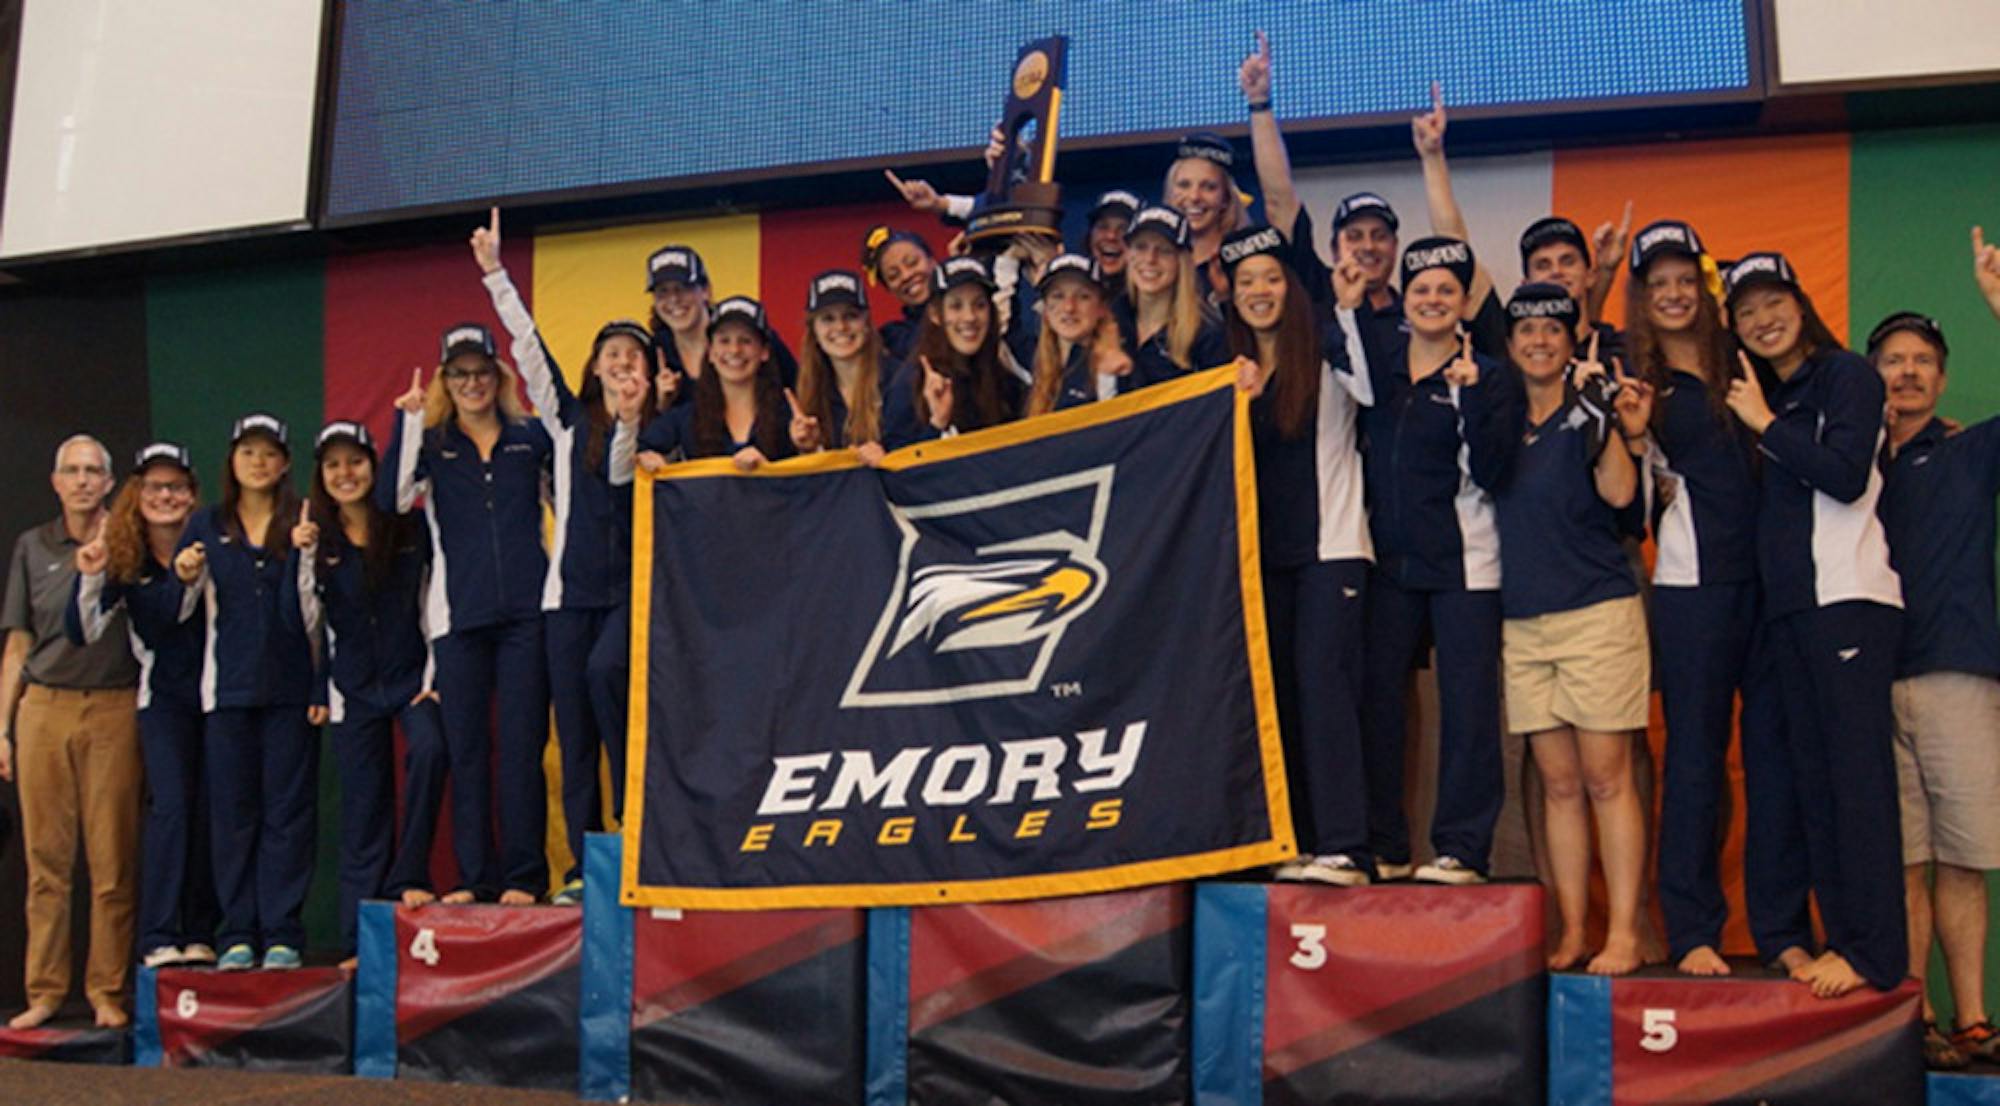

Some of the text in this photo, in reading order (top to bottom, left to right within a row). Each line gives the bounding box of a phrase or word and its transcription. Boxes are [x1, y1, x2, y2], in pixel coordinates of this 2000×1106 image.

[1051, 681, 1083, 698] TM
[757, 720, 1148, 816] EMORY
[740, 799, 1123, 852] EAGLES
[410, 928, 440, 966] 4
[1290, 923, 1328, 970] 3
[177, 989, 199, 1018] 6
[1640, 1008, 1678, 1052] 5
